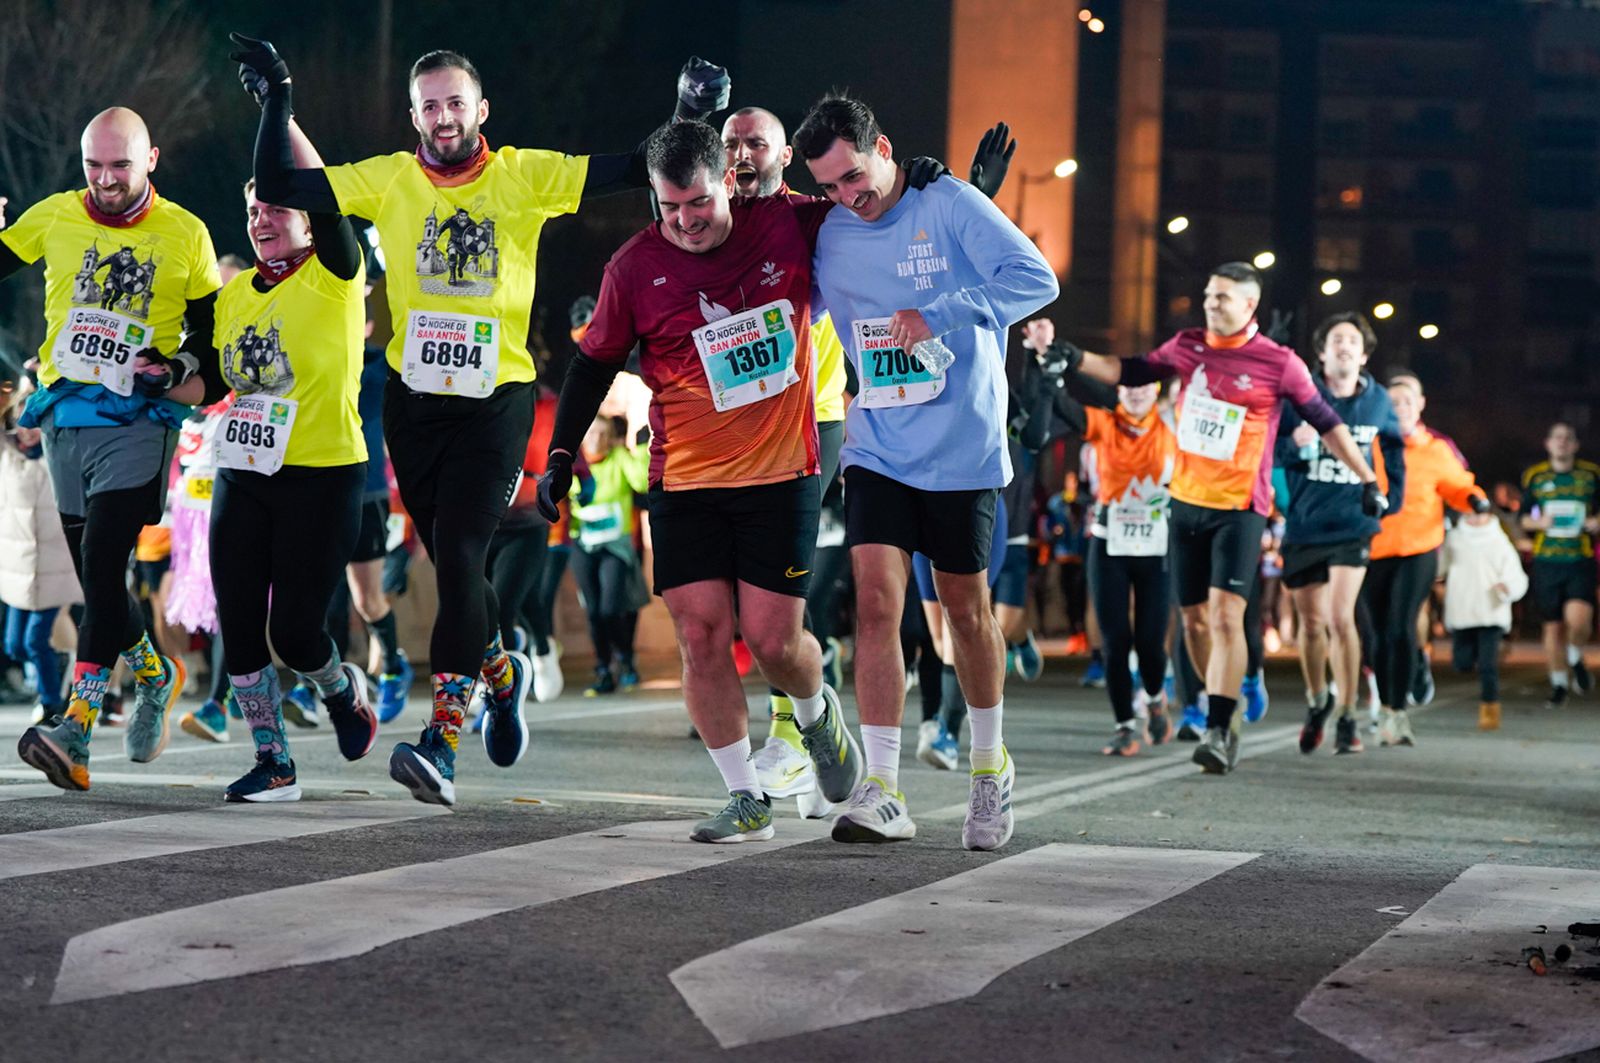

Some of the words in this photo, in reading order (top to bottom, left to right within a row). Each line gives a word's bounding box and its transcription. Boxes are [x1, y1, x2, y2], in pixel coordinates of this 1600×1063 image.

[72, 324, 89, 332] SAN
[84, 316, 108, 327] NOCHE
[110, 321, 120, 329] DE
[428, 321, 455, 330] NOCHE
[456, 323, 467, 331] DE
[717, 323, 746, 340] NOCHE
[746, 319, 758, 332] DE
[416, 330, 433, 339] SAN
[435, 331, 466, 342] ANTÓN
[872, 328, 891, 337] NOCH
[70, 332, 131, 365] 6895
[709, 341, 729, 354] SAN
[730, 329, 761, 348] ANTÓN
[865, 340, 879, 350] SAN
[880, 338, 905, 349] ANT
[421, 340, 482, 370] 6894
[724, 336, 780, 377] 1367
[226, 419, 276, 448] 6893
[1194, 418, 1225, 439] 1021
[1123, 523, 1153, 537] 7212
